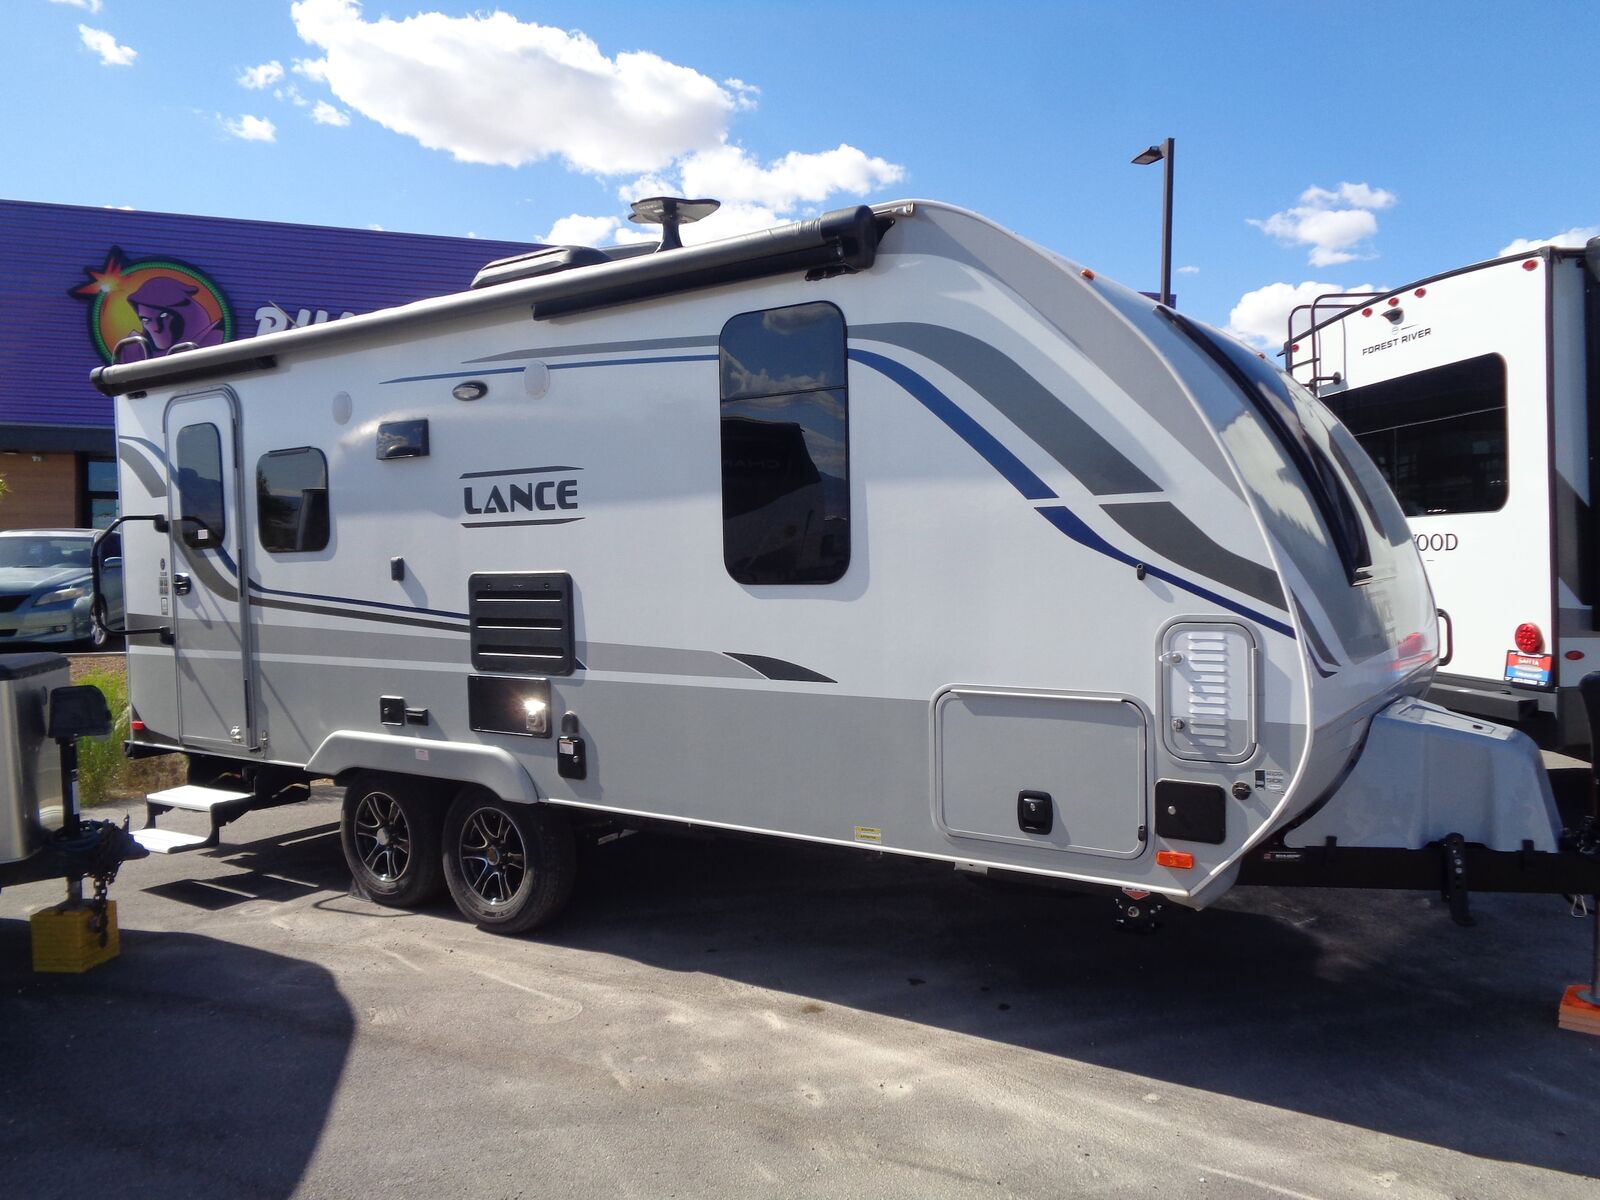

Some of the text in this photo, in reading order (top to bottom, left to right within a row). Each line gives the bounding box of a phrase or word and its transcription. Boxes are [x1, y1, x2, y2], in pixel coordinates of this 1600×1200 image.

[1362, 327, 1432, 356] FOREST RIVER
[463, 479, 578, 515] LANCE
[1414, 533, 1458, 551] OOD
